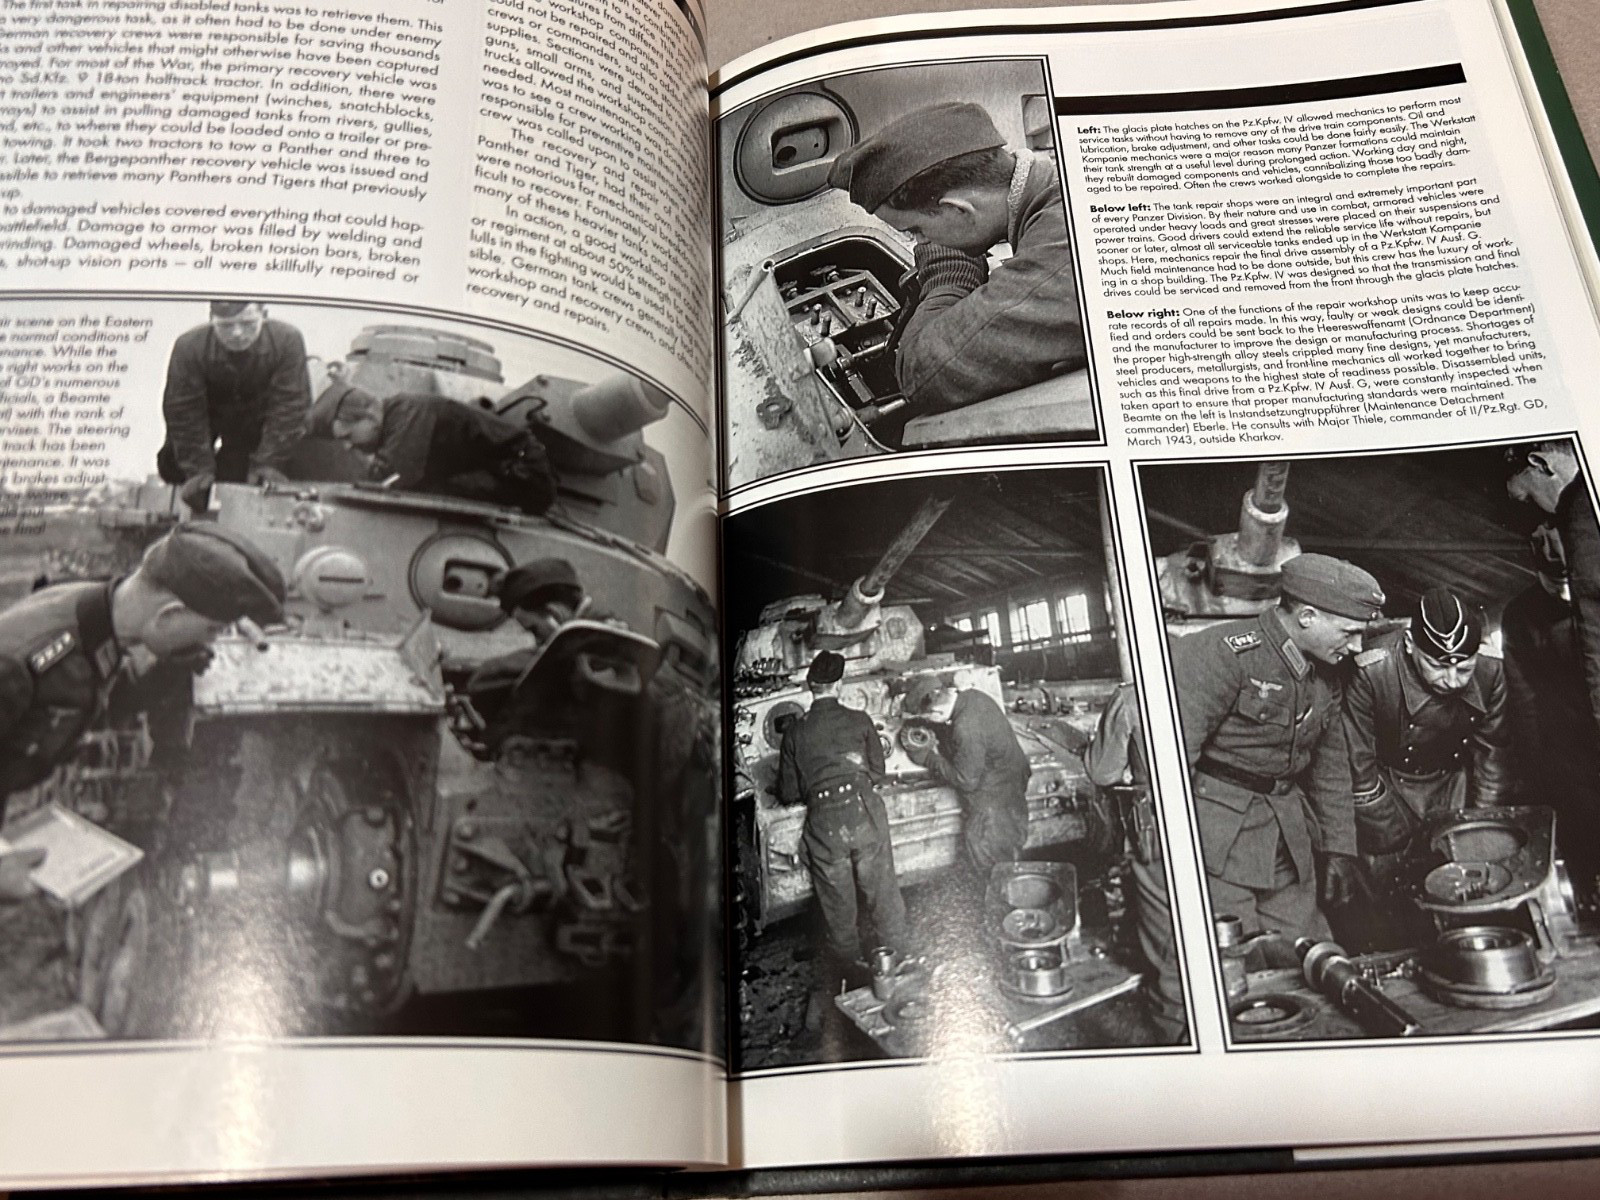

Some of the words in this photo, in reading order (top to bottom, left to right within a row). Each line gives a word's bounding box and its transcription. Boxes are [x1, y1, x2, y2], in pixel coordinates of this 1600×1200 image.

[322, 9, 373, 21] retrieve
[376, 12, 413, 27] them.
[418, 18, 443, 31] This
[487, 20, 539, 43] supplies.
[546, 37, 594, 66] Sections
[289, 66, 350, 82] recovery
[356, 70, 403, 84] vehicle
[409, 79, 437, 89] was
[484, 46, 521, 66] trucks
[524, 59, 573, 84] allowed
[577, 77, 594, 94] the
[182, 90, 258, 104] equipment
[266, 92, 332, 109] (winches,
[339, 101, 434, 121] snatchblocks,
[483, 62, 535, 85] needed.
[540, 77, 571, 98] Most
[575, 93, 642, 136] maintenance
[1122, 125, 1148, 133] glacis
[1151, 123, 1172, 132] plate
[1175, 121, 1209, 129] hatches
[1243, 117, 1281, 126] Pz.Kpfw.
[1297, 112, 1333, 121] allowed
[1336, 108, 1385, 118] mechanics
[1399, 102, 1436, 113] perform
[1439, 97, 1461, 105] most
[1160, 142, 1210, 151] adjustment,
[1212, 139, 1231, 147] and
[1259, 136, 1281, 144] tasks
[1283, 134, 1309, 142] could
[1353, 128, 1377, 136] fairly
[1380, 124, 1408, 133] easily.
[1430, 115, 1476, 127] Werkstatt
[191, 157, 256, 170] recovery
[260, 156, 311, 170] vehicle
[316, 163, 345, 173] was
[350, 163, 395, 177] issued
[400, 169, 428, 181] and
[477, 133, 528, 157] Panther
[534, 153, 559, 167] and
[565, 159, 598, 185] Tiger,
[604, 175, 624, 197] had
[511, 127, 534, 144] The
[542, 140, 596, 170] recovery
[603, 164, 624, 182] and
[170, 169, 232, 182] Panthers
[237, 171, 265, 183] and
[272, 173, 315, 189] Tigers
[320, 176, 347, 189] that
[352, 182, 426, 201] previously
[475, 163, 507, 182] ficult
[530, 182, 580, 205] recover.
[1090, 204, 1126, 212] Below
[1173, 201, 1193, 209] tank
[1196, 201, 1223, 209] repair
[1226, 199, 1253, 207] shops
[1297, 192, 1332, 203] integral
[1335, 190, 1354, 199] and
[1357, 186, 1404, 197] extremely
[1406, 180, 1454, 192] important
[1456, 177, 1477, 188] part
[313, 209, 340, 222] that
[345, 214, 387, 226] could
[391, 215, 424, 233] hap-
[1093, 225, 1136, 235] operated
[1168, 223, 1198, 231] heavy
[1229, 219, 1247, 227] and
[1251, 219, 1275, 228] great
[1342, 210, 1376, 222] placed
[1419, 200, 1478, 212] suspensions
[1480, 194, 1500, 204] and
[193, 255, 211, 268] all
[220, 260, 257, 270] were
[264, 258, 323, 277] skillfully
[330, 266, 395, 280] repaired
[403, 273, 419, 282] or
[466, 282, 529, 308] recovery
[533, 298, 559, 313] and
[564, 307, 609, 331] repairs.
[468, 265, 535, 293] workshop
[540, 283, 566, 298] and
[570, 293, 621, 325] recovery
[1107, 310, 1145, 318] Below
[1148, 308, 1180, 319] right:
[1208, 306, 1219, 314] of
[1221, 306, 1236, 314] the
[1239, 305, 1282, 313] functions
[1285, 302, 1295, 310] of
[1297, 302, 1313, 310] the
[1316, 300, 1346, 310] repair
[1348, 296, 1398, 306] workshop
[1401, 294, 1423, 302] units
[1463, 287, 1490, 296] keep
[1492, 284, 1520, 292] accu-
[80, 315, 100, 325] the
[105, 315, 153, 325] Eastern
[17, 406, 44, 417] with
[49, 406, 69, 417] the
[75, 406, 103, 417] rank
[109, 406, 124, 417] of
[1125, 424, 1190, 433] commander)
[1193, 422, 1228, 431] Eberle.
[1251, 420, 1290, 428] consults
[1293, 418, 1314, 426] with
[1317, 417, 1350, 427] Major
[1352, 414, 1386, 423] Thiele,
[1389, 409, 1453, 421] commander
[1456, 407, 1467, 416] of
[1470, 403, 1520, 415] II/Pz.Rgt.
[1523, 399, 1547, 408] GD,
[1181, 411, 1197, 419] the
[1229, 404, 1360, 417] Instandsetzungtruppführer
[1363, 400, 1436, 412] (Maintenance
[1440, 391, 1505, 404] Detachment
[1128, 436, 1161, 445] March
[1166, 436, 1196, 444] 1943,
[1200, 434, 1235, 442] outside
[1239, 432, 1284, 441] Kharkov.
